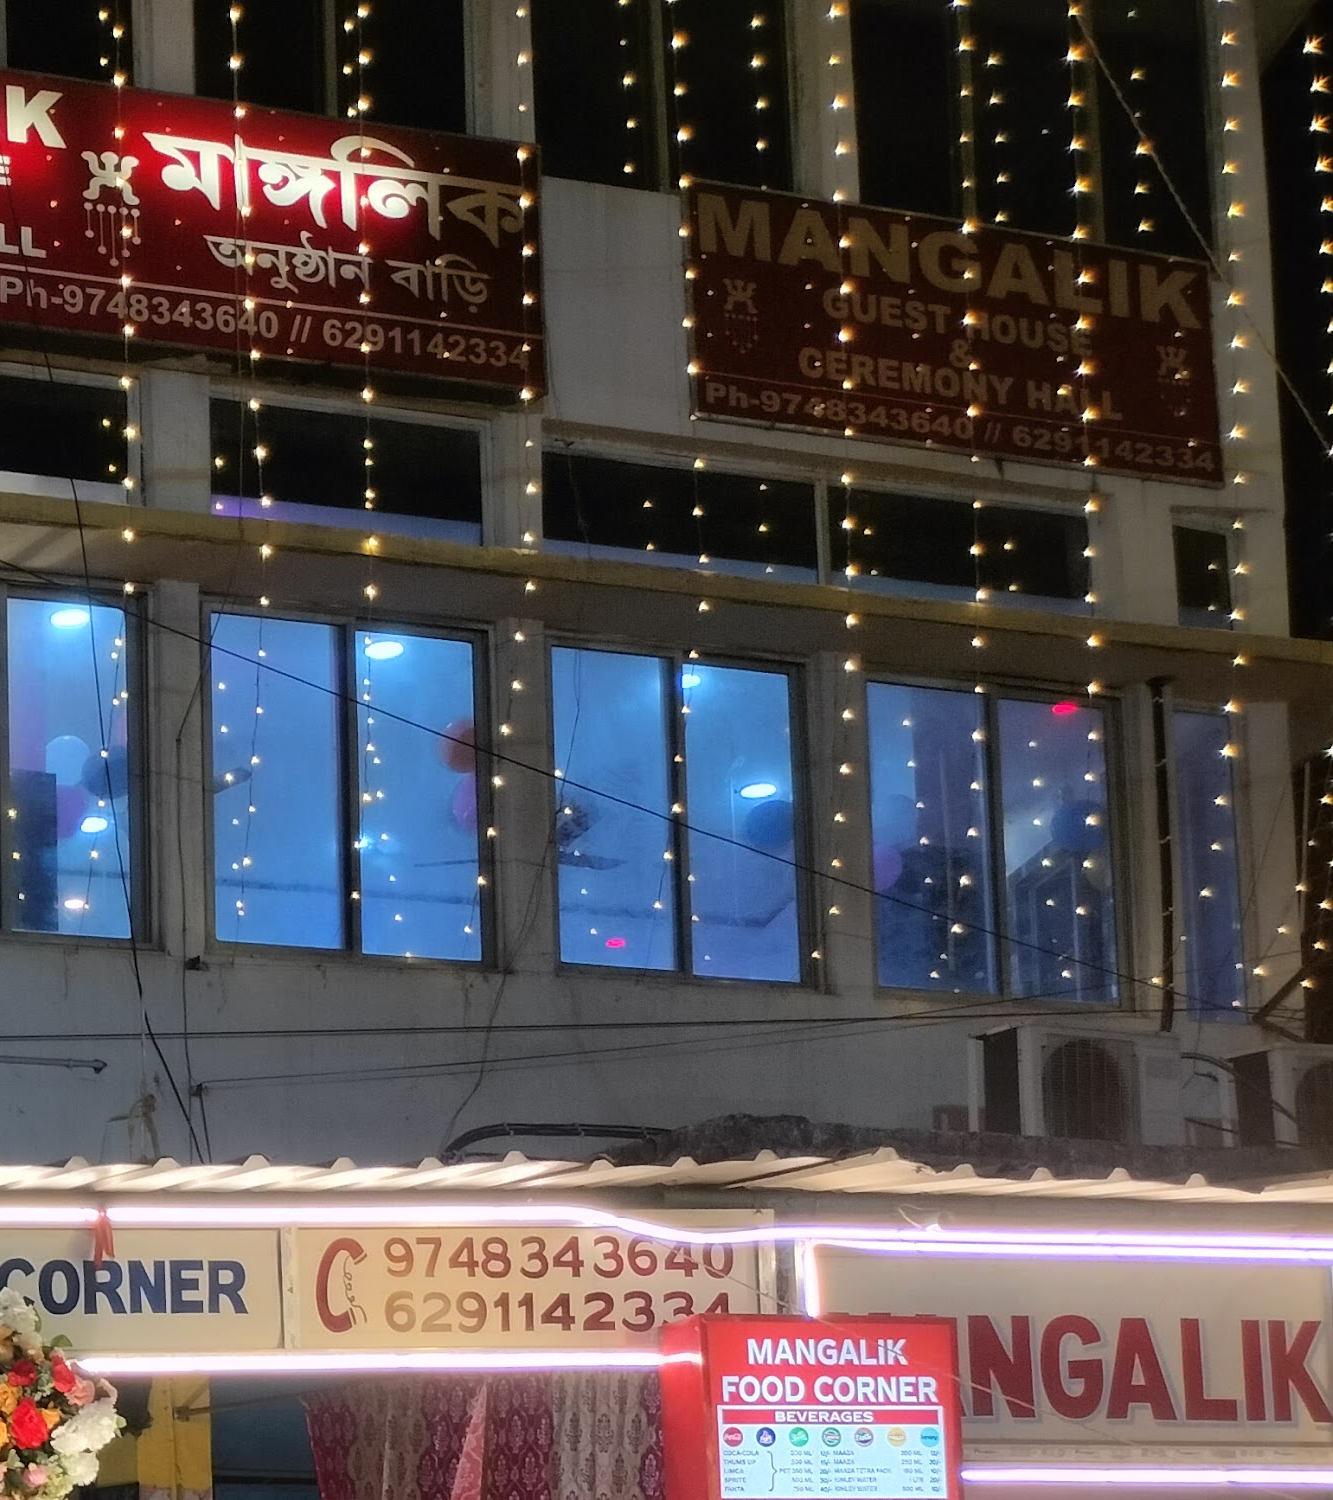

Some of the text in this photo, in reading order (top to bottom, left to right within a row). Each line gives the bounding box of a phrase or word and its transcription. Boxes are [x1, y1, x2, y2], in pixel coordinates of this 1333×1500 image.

[142, 132, 526, 248] মাঙ্গলিক
[202, 230, 491, 312] অনুষ্ঠান বাড়ি
[696, 192, 1203, 330] MANGALIK
[0, 275, 279, 340] Ph-9748343640
[323, 319, 531, 371] 6291142334
[822, 288, 1093, 357] GUEST HOUSE
[948, 339, 975, 368] &
[798, 346, 1124, 421] CEREMONY HALL
[1013, 425, 1215, 473] 6291142334
[385, 1235, 734, 1280] 9748343640
[385, 1290, 730, 1333] 6291142334
[747, 1337, 909, 1367] MANGALIK
[961, 1313, 1333, 1424] NGALIK
[721, 1375, 940, 1403] FOOD CORNER
[774, 1410, 875, 1424] BEVERAGES
